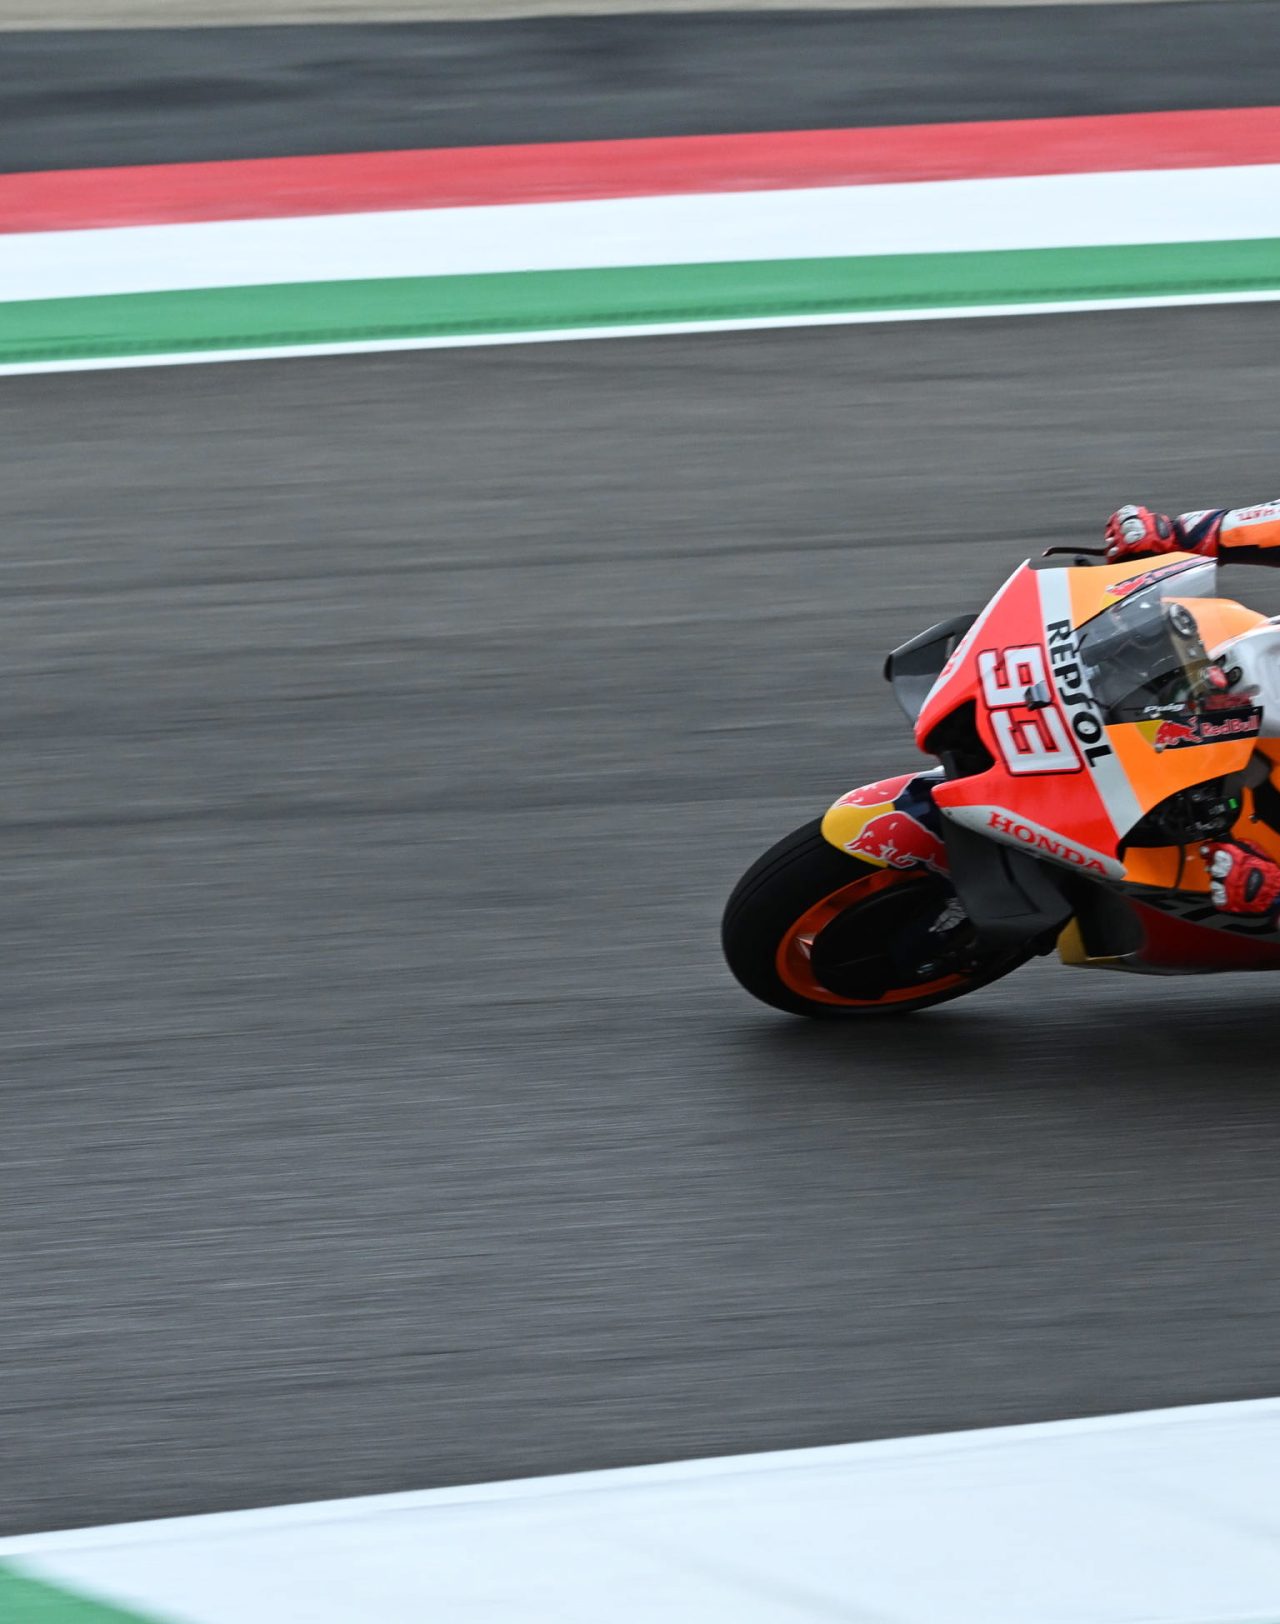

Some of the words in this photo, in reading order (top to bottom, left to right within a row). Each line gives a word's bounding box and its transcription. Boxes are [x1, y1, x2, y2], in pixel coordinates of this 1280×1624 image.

[979, 645, 1084, 777] 93
[1047, 619, 1113, 768] REPSOL
[1143, 702, 1186, 713] Puig
[987, 811, 1108, 876] HONDA
